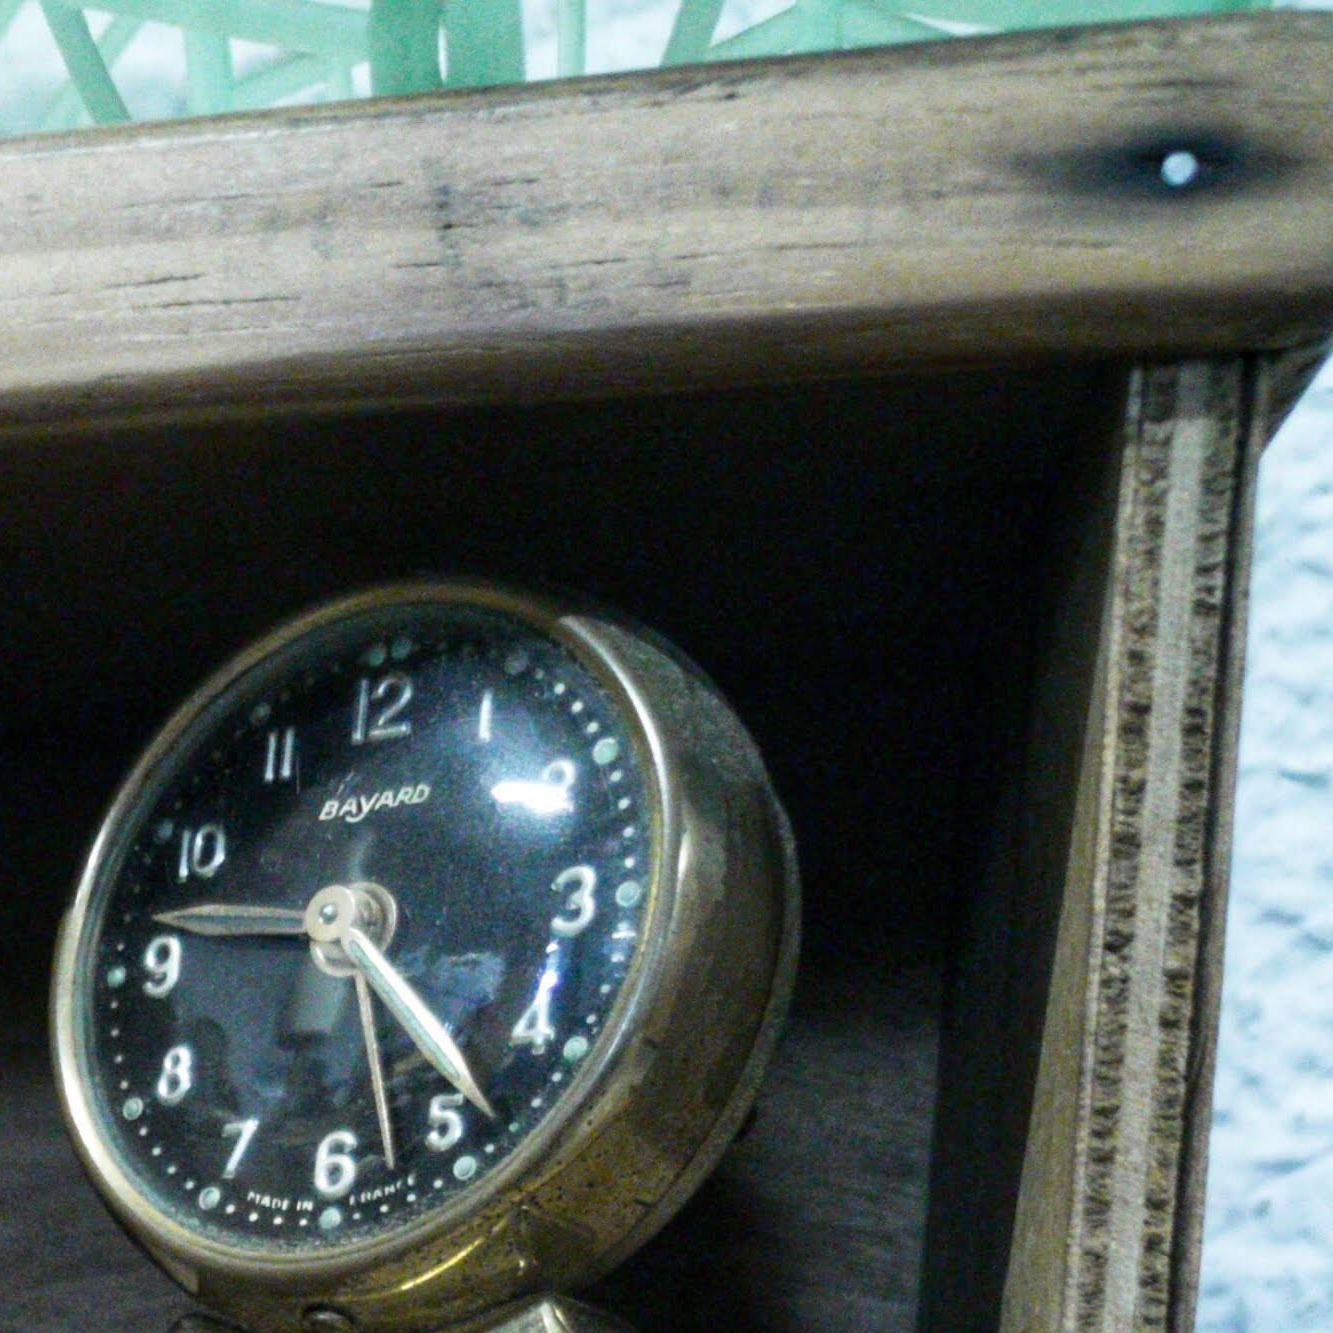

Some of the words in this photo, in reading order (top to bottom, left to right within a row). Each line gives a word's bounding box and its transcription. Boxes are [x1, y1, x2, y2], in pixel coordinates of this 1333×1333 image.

[351, 674, 412, 745] 12
[478, 689, 494, 742] 1
[263, 729, 296, 784] 11
[318, 783, 431, 823] BAYARD
[177, 824, 226, 881] 10
[551, 864, 597, 936] 3
[142, 935, 182, 999] 9
[511, 988, 555, 1056] 4
[156, 1043, 193, 1104] 8
[222, 1117, 260, 1178] 7
[426, 1093, 465, 1150] 5
[312, 1130, 359, 1195] 6
[247, 1191, 289, 1211] MADE
[296, 1200, 314, 1212] IN
